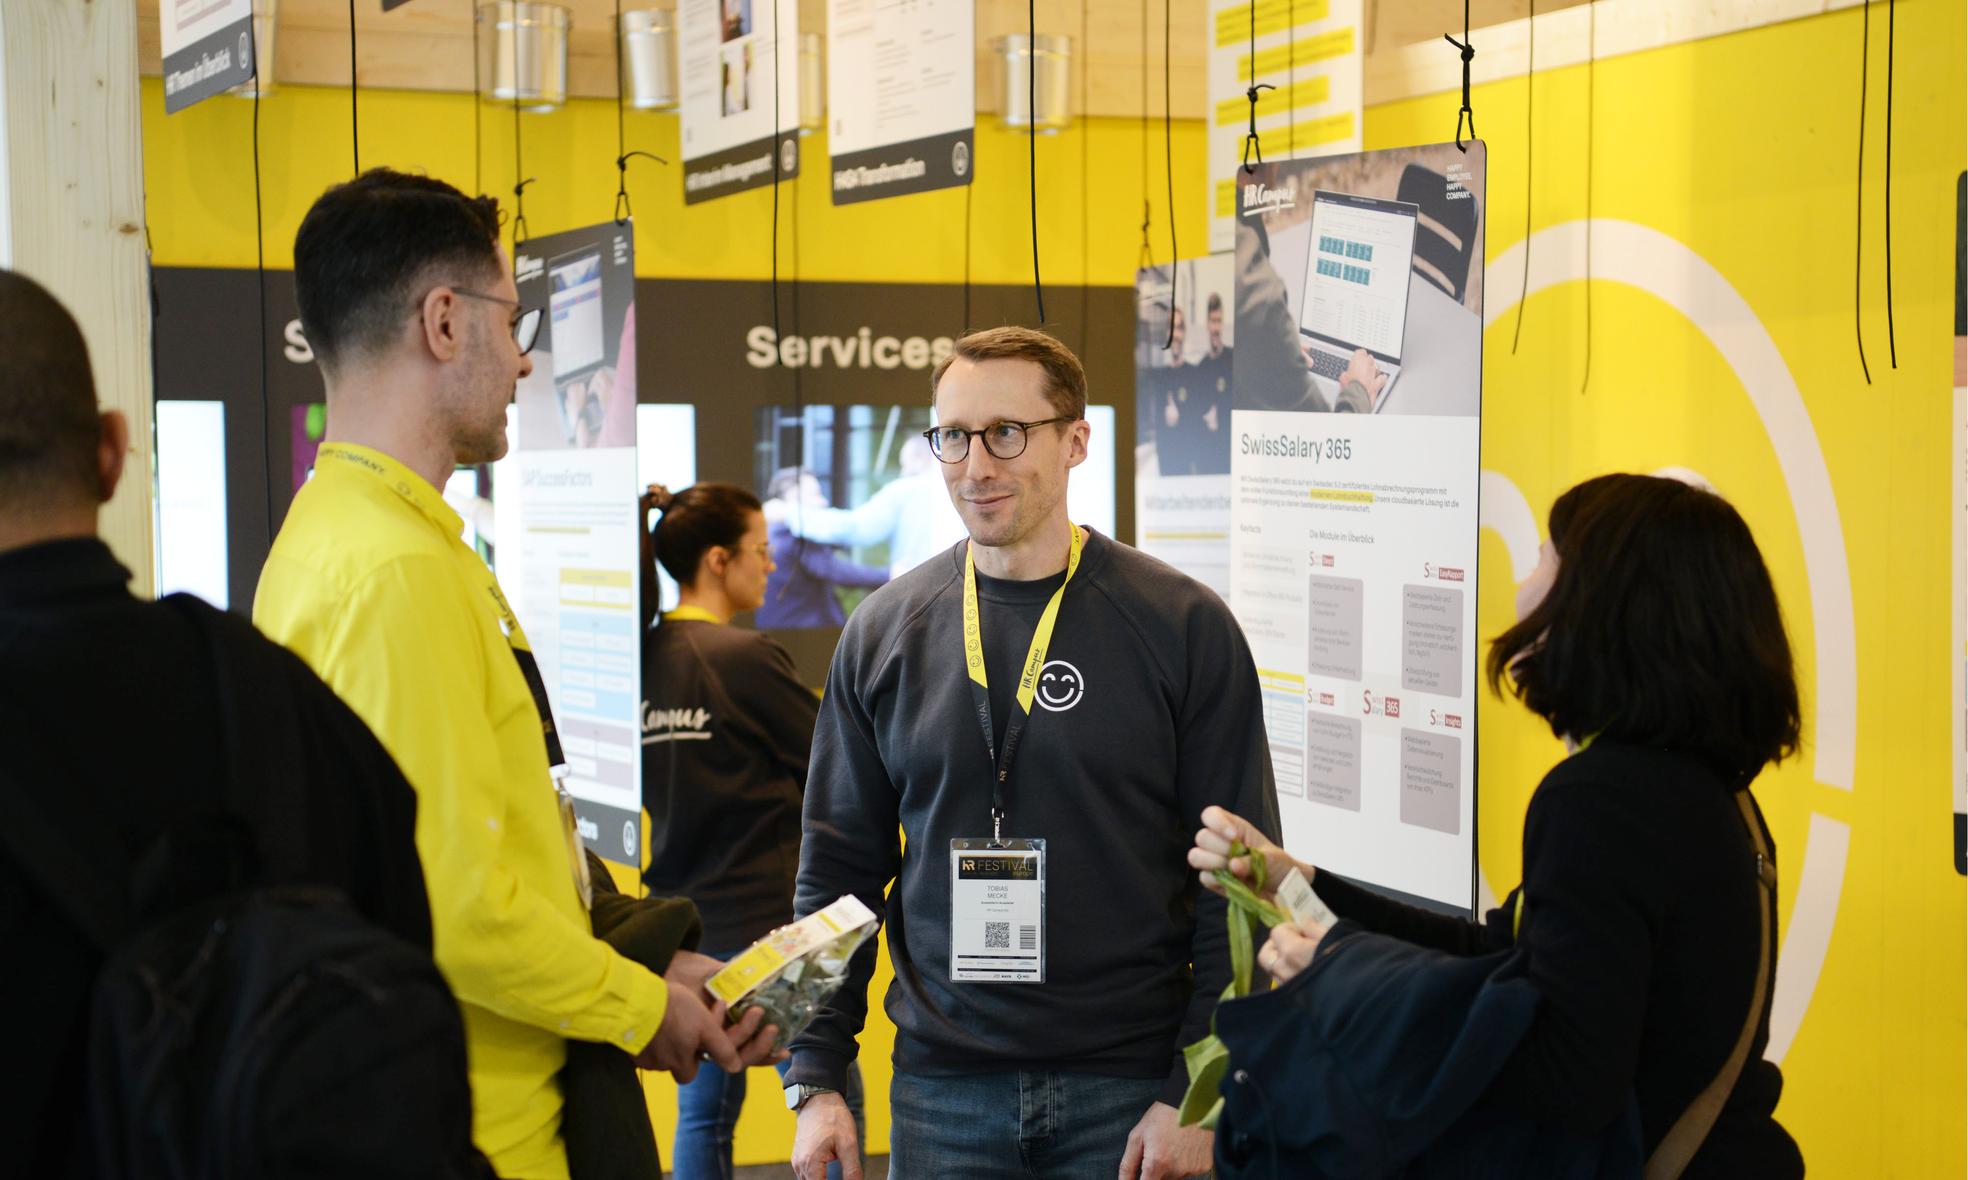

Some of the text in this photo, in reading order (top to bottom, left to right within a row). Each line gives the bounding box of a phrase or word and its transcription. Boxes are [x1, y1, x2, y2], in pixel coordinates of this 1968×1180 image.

[721, 153, 772, 183] Management
[858, 157, 925, 187] Transformation
[1243, 186, 1257, 207] HR
[1446, 182, 1462, 191] HAPPY
[747, 326, 952, 370] Services
[1241, 433, 1352, 464] SwissSalary 365
[1391, 496, 1424, 505] cloudbasierte
[1425, 498, 1443, 508] Lösung
[1309, 529, 1375, 544] Die Module im Überblick
[1022, 647, 1042, 690] HR Campus
[1386, 698, 1399, 716] 365
[977, 699, 995, 747] FESTIVAL
[962, 859, 1034, 871] HR FESTIVAL
